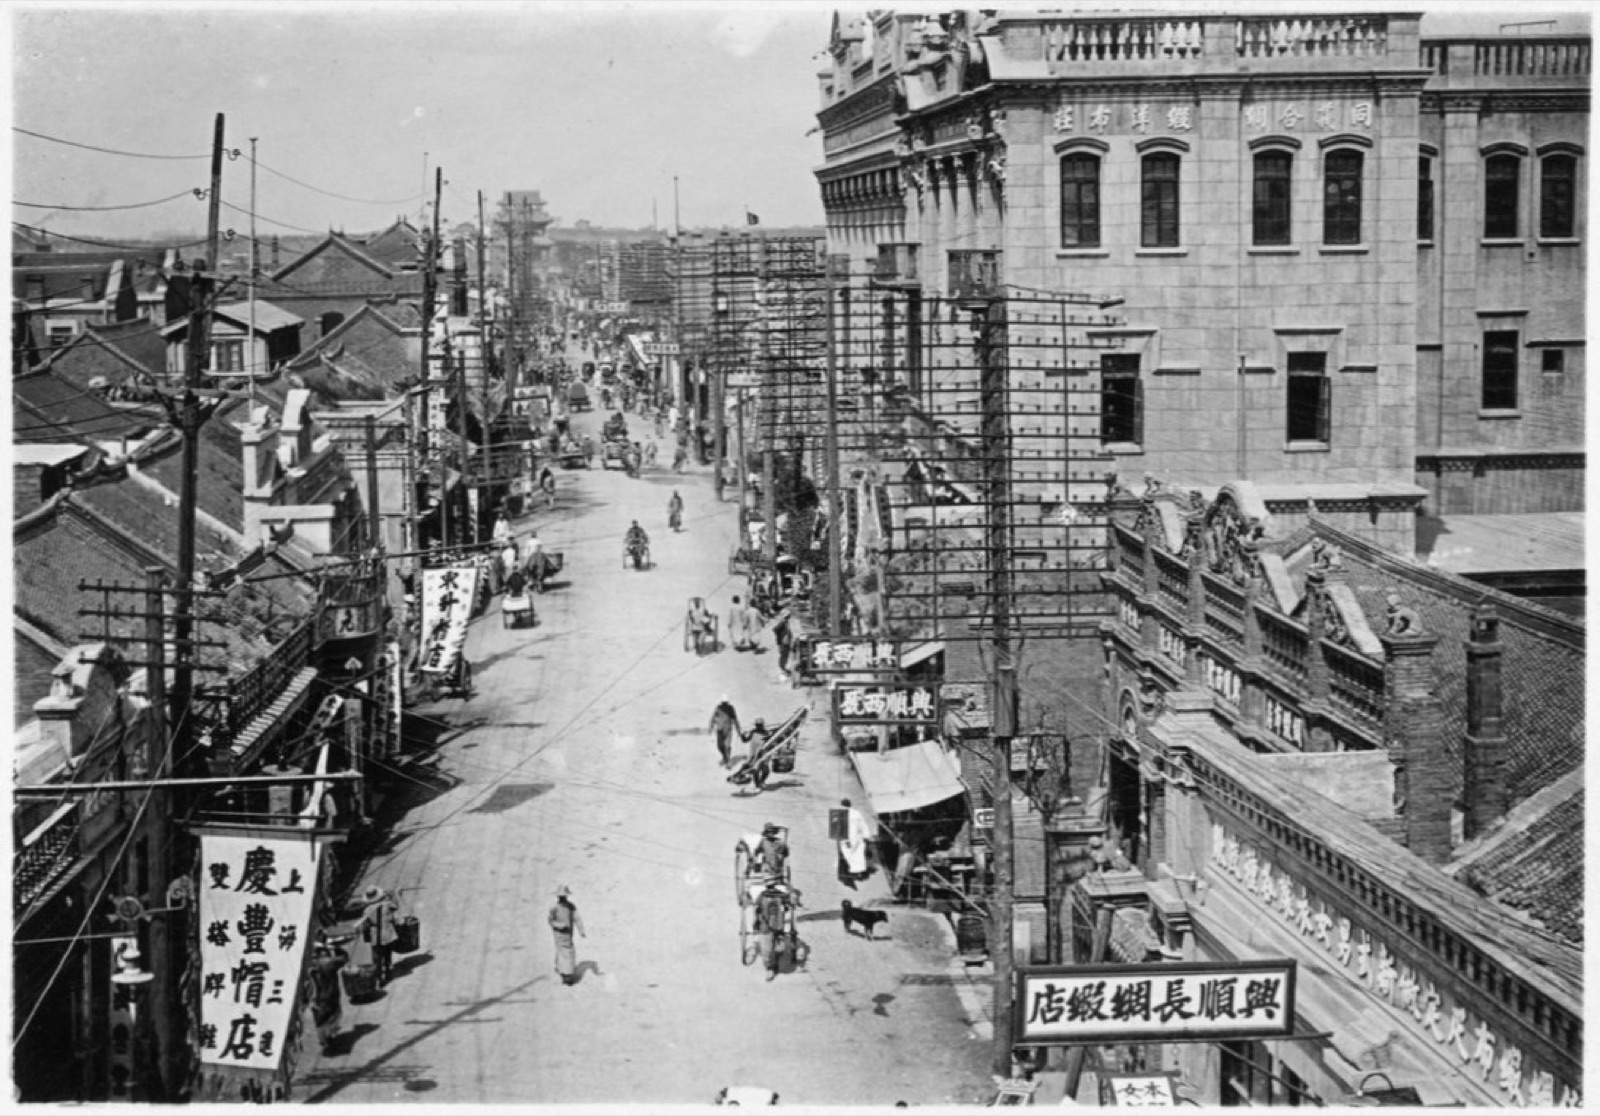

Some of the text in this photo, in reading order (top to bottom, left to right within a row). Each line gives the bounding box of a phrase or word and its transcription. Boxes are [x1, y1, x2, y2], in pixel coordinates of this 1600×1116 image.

[219, 845, 278, 1061] 慶豐帽店
[1028, 976, 1281, 1025] 興順長綢緞店
